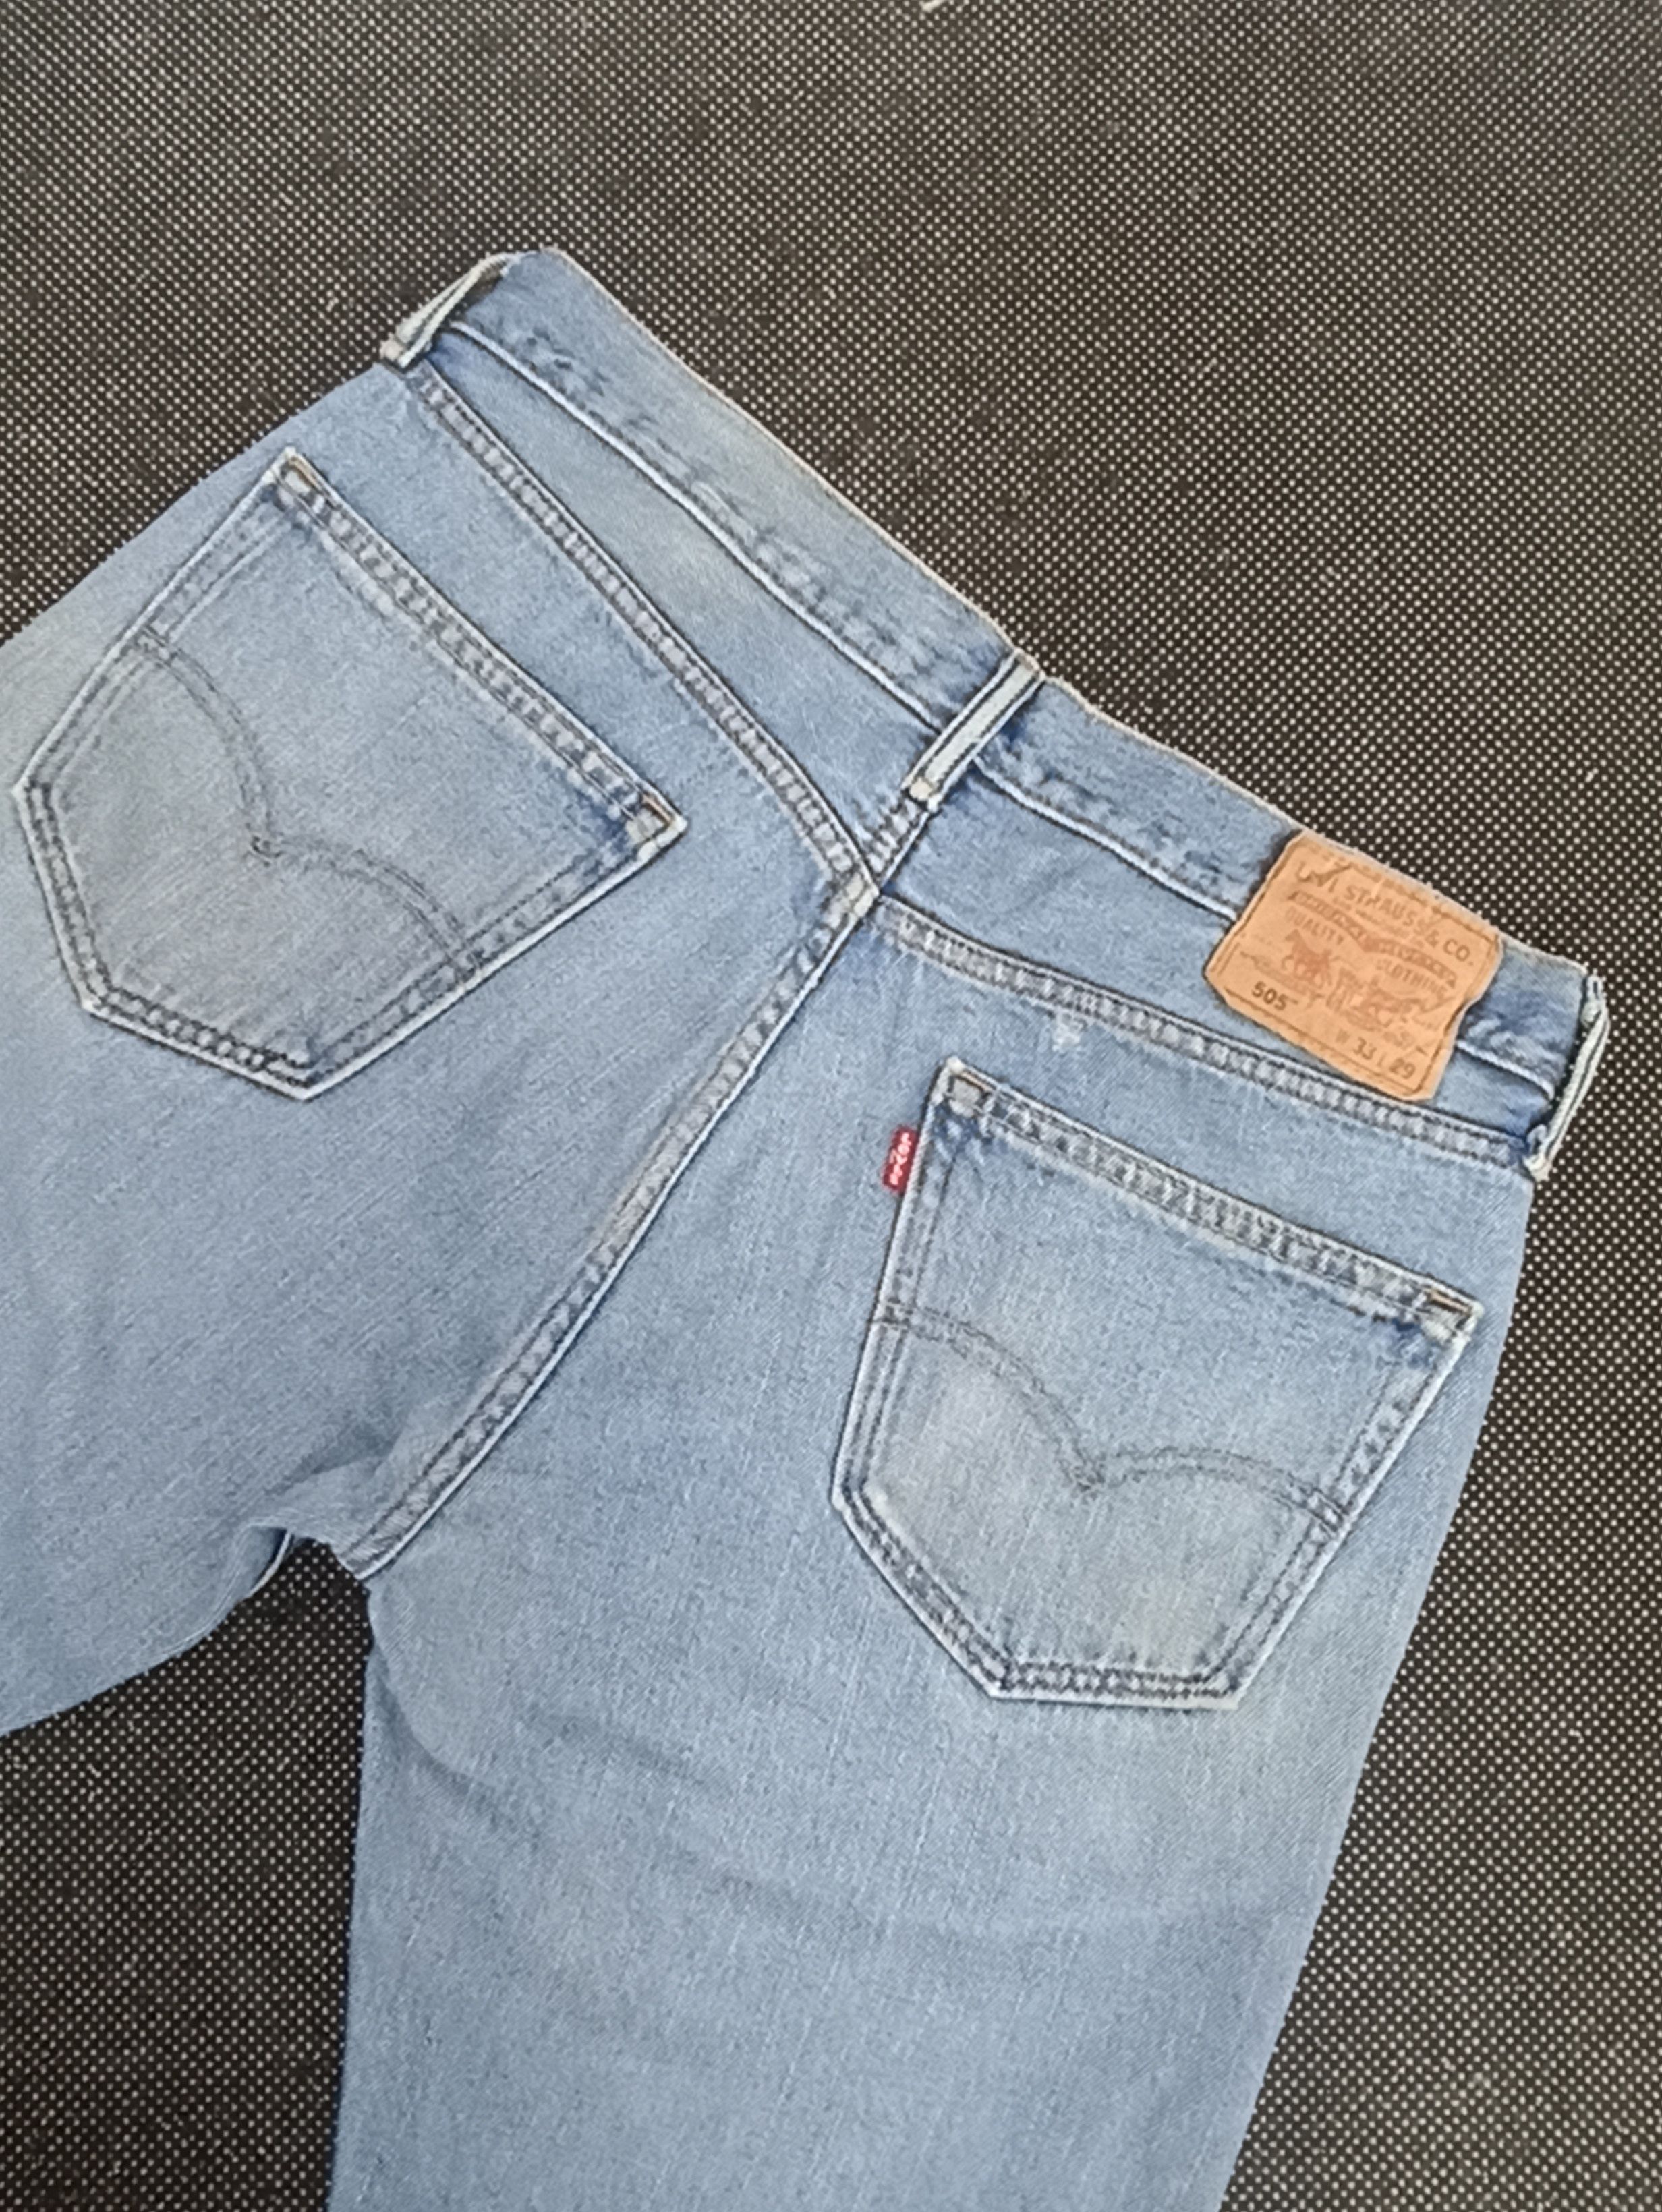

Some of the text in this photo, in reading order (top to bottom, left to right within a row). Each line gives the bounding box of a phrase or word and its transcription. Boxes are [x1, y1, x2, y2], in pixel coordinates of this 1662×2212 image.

[1343, 885, 1426, 936] STRAUSS
[1425, 929, 1439, 948] &
[1442, 938, 1474, 966] CO.
[1389, 1057, 1416, 1080] 29
